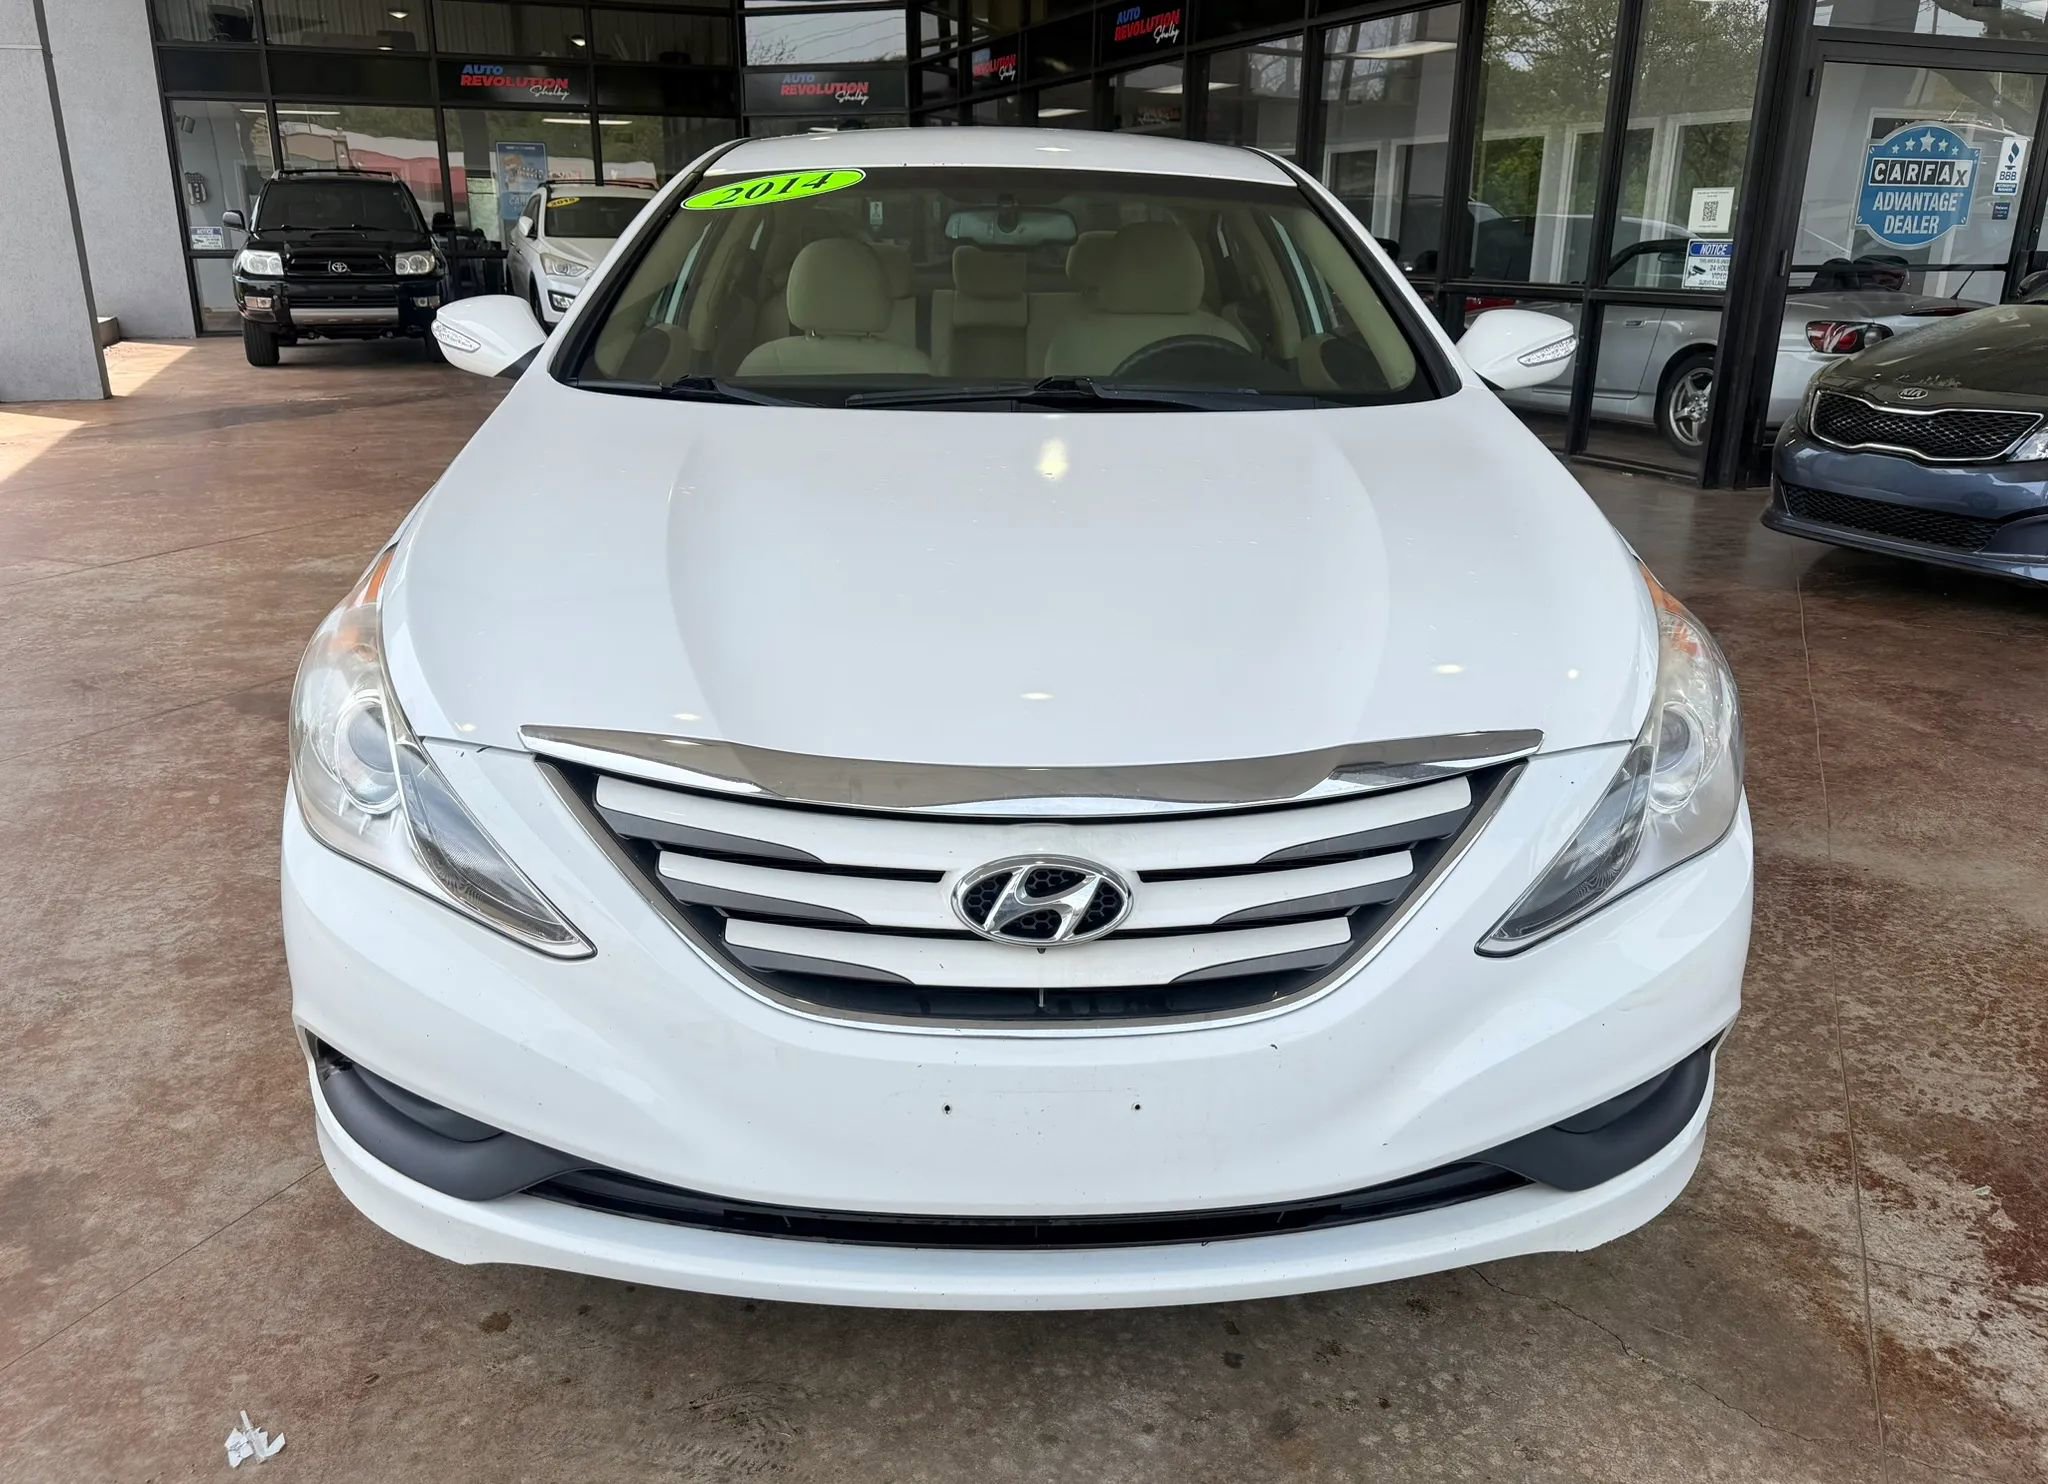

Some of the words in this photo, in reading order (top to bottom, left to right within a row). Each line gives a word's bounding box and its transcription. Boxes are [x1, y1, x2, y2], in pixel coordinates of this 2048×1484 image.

[1117, 6, 1140, 24] AUTO
[1114, 9, 1180, 41] REVOLUTION
[1153, 21, 1180, 44] Shelby
[462, 64, 503, 75] AUTO
[461, 75, 569, 89] REVOLUTION
[783, 74, 815, 84] AUTO
[529, 84, 570, 101] Shelby
[781, 82, 869, 96] REVOLUTION
[835, 90, 869, 105] Shelby
[1874, 163, 1968, 186] CARFAX
[1999, 171, 2017, 181] BBB
[712, 172, 834, 207] 2014
[1883, 215, 1940, 235] DEALER
[1700, 244, 1728, 256] NOTICE
[1717, 264, 1728, 272] HOU
